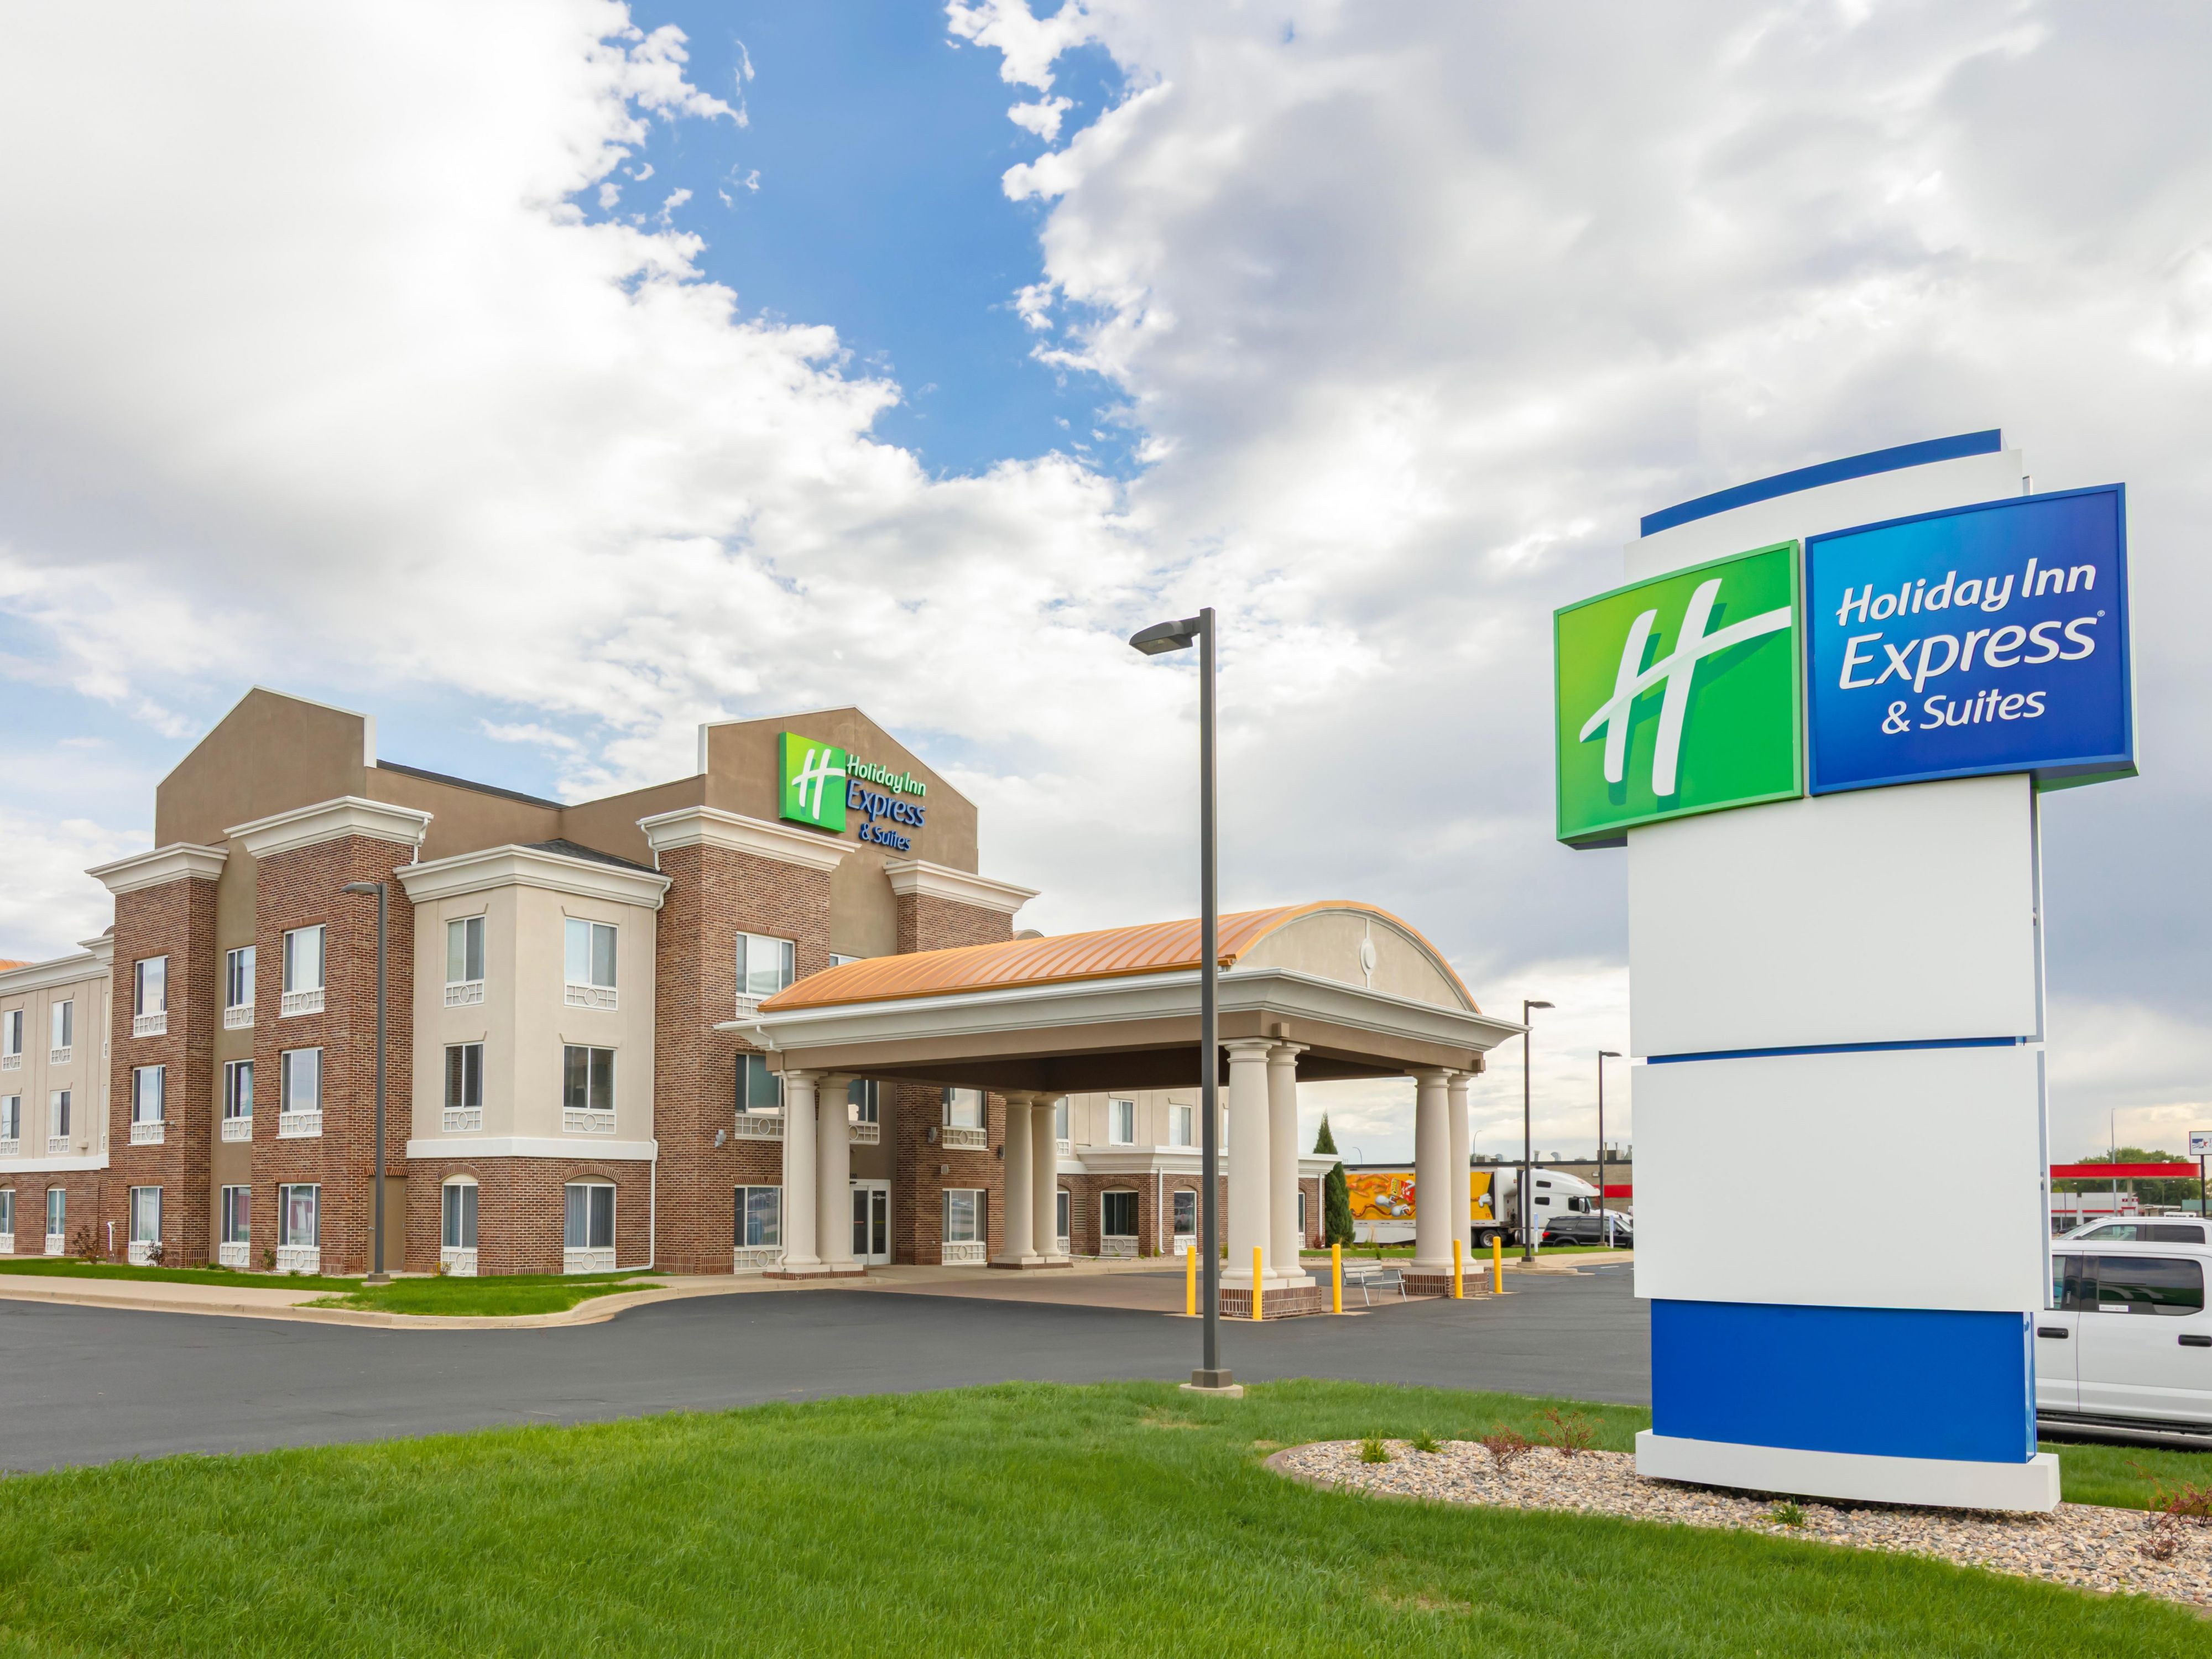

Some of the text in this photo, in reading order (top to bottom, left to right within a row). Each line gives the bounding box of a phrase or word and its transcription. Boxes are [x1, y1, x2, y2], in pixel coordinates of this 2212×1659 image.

[1835, 557, 2096, 627] Holiday Inn
[1881, 688, 2047, 734] & Suites
[846, 754, 926, 796] Holiday Inn
[846, 779, 926, 827] Express
[859, 823, 911, 851] & Suites
